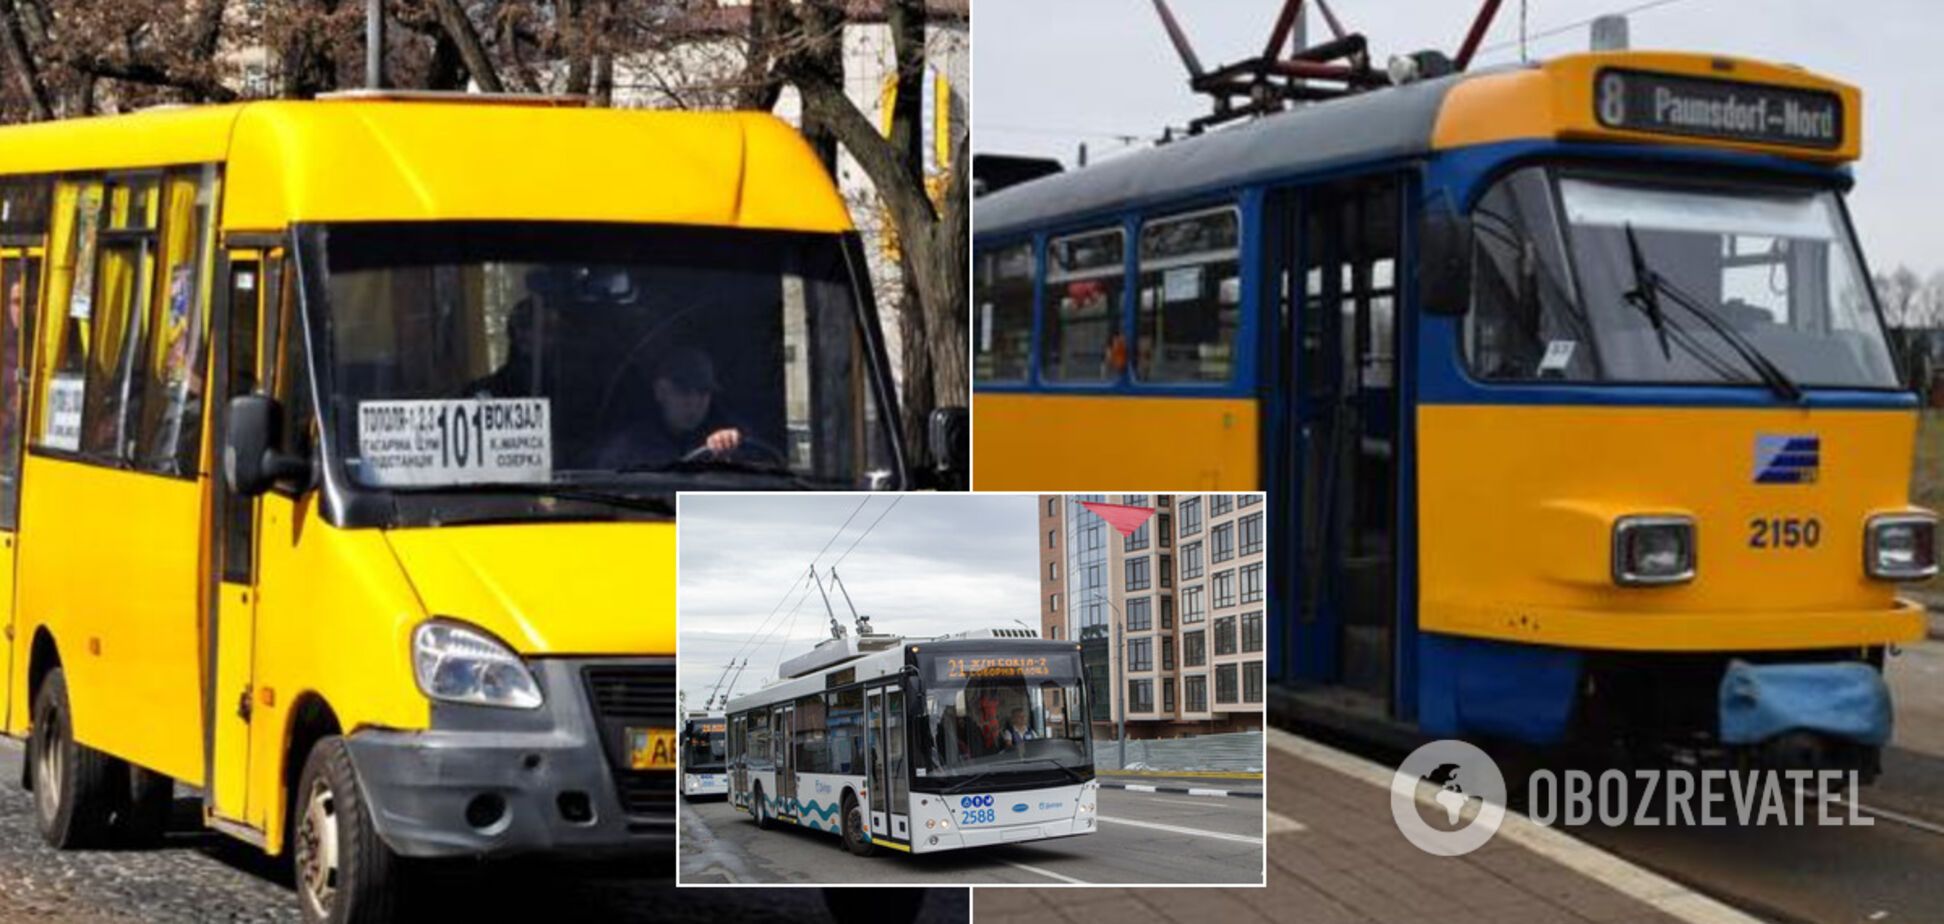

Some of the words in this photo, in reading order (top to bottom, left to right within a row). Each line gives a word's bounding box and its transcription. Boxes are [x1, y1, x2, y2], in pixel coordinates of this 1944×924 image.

[1601, 71, 1625, 126] 8
[485, 402, 544, 431] ВОКЗАЛ
[437, 404, 484, 468] 101
[496, 453, 543, 467] ОЗЕРКА
[1748, 518, 1822, 549] 2150
[948, 658, 965, 678] 21
[961, 808, 996, 825] 2588
